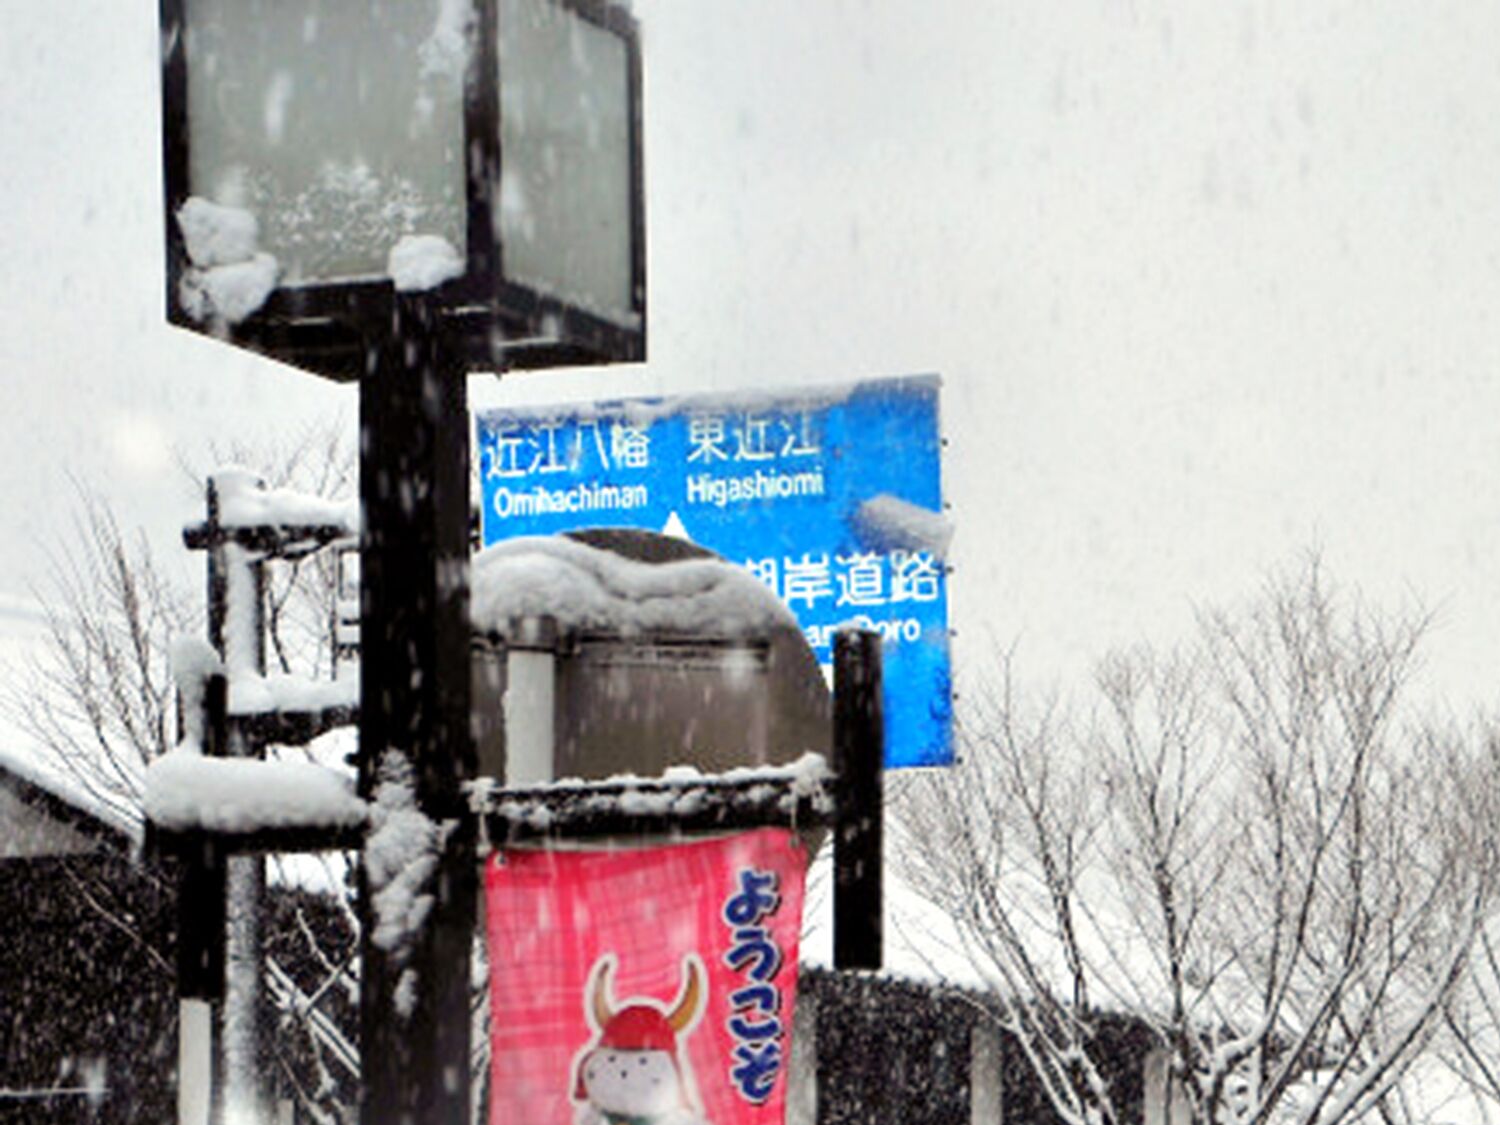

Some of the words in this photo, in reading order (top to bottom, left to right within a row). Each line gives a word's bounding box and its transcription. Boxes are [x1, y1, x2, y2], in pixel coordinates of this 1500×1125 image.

[485, 423, 650, 480] 近江八幡
[686, 412, 820, 463] 東近江
[494, 482, 648, 518] Omihachiman
[686, 466, 824, 507] Higashiomi
[724, 869, 783, 1105] ようこそ
